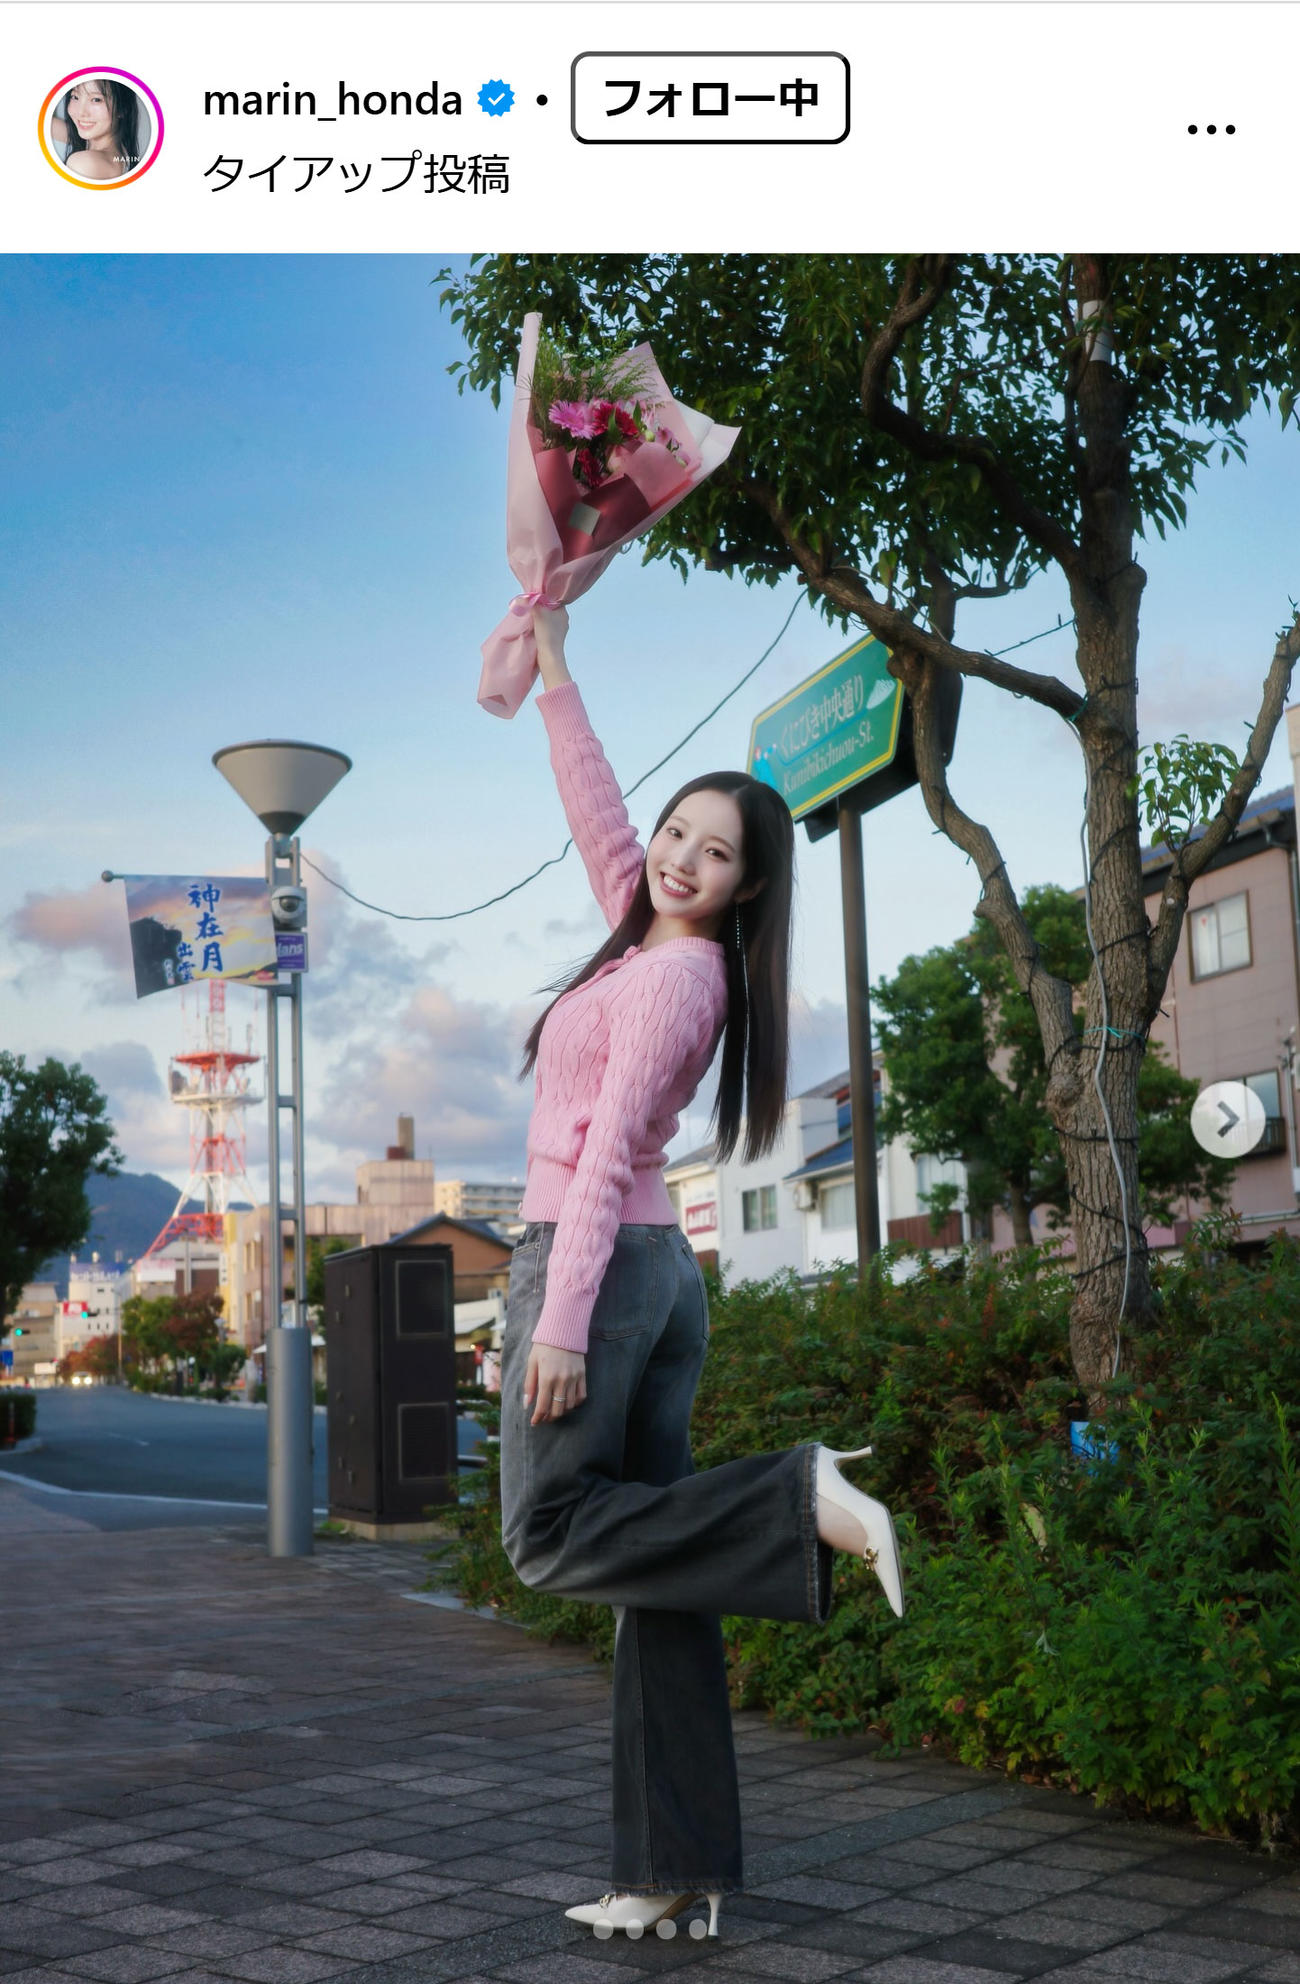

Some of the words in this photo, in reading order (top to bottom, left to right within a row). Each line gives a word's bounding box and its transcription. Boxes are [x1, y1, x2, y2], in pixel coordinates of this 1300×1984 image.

[782, 674, 864, 758] くにびき中央通り
[177, 942, 195, 981] 出雲
[187, 883, 223, 972] 神在月
